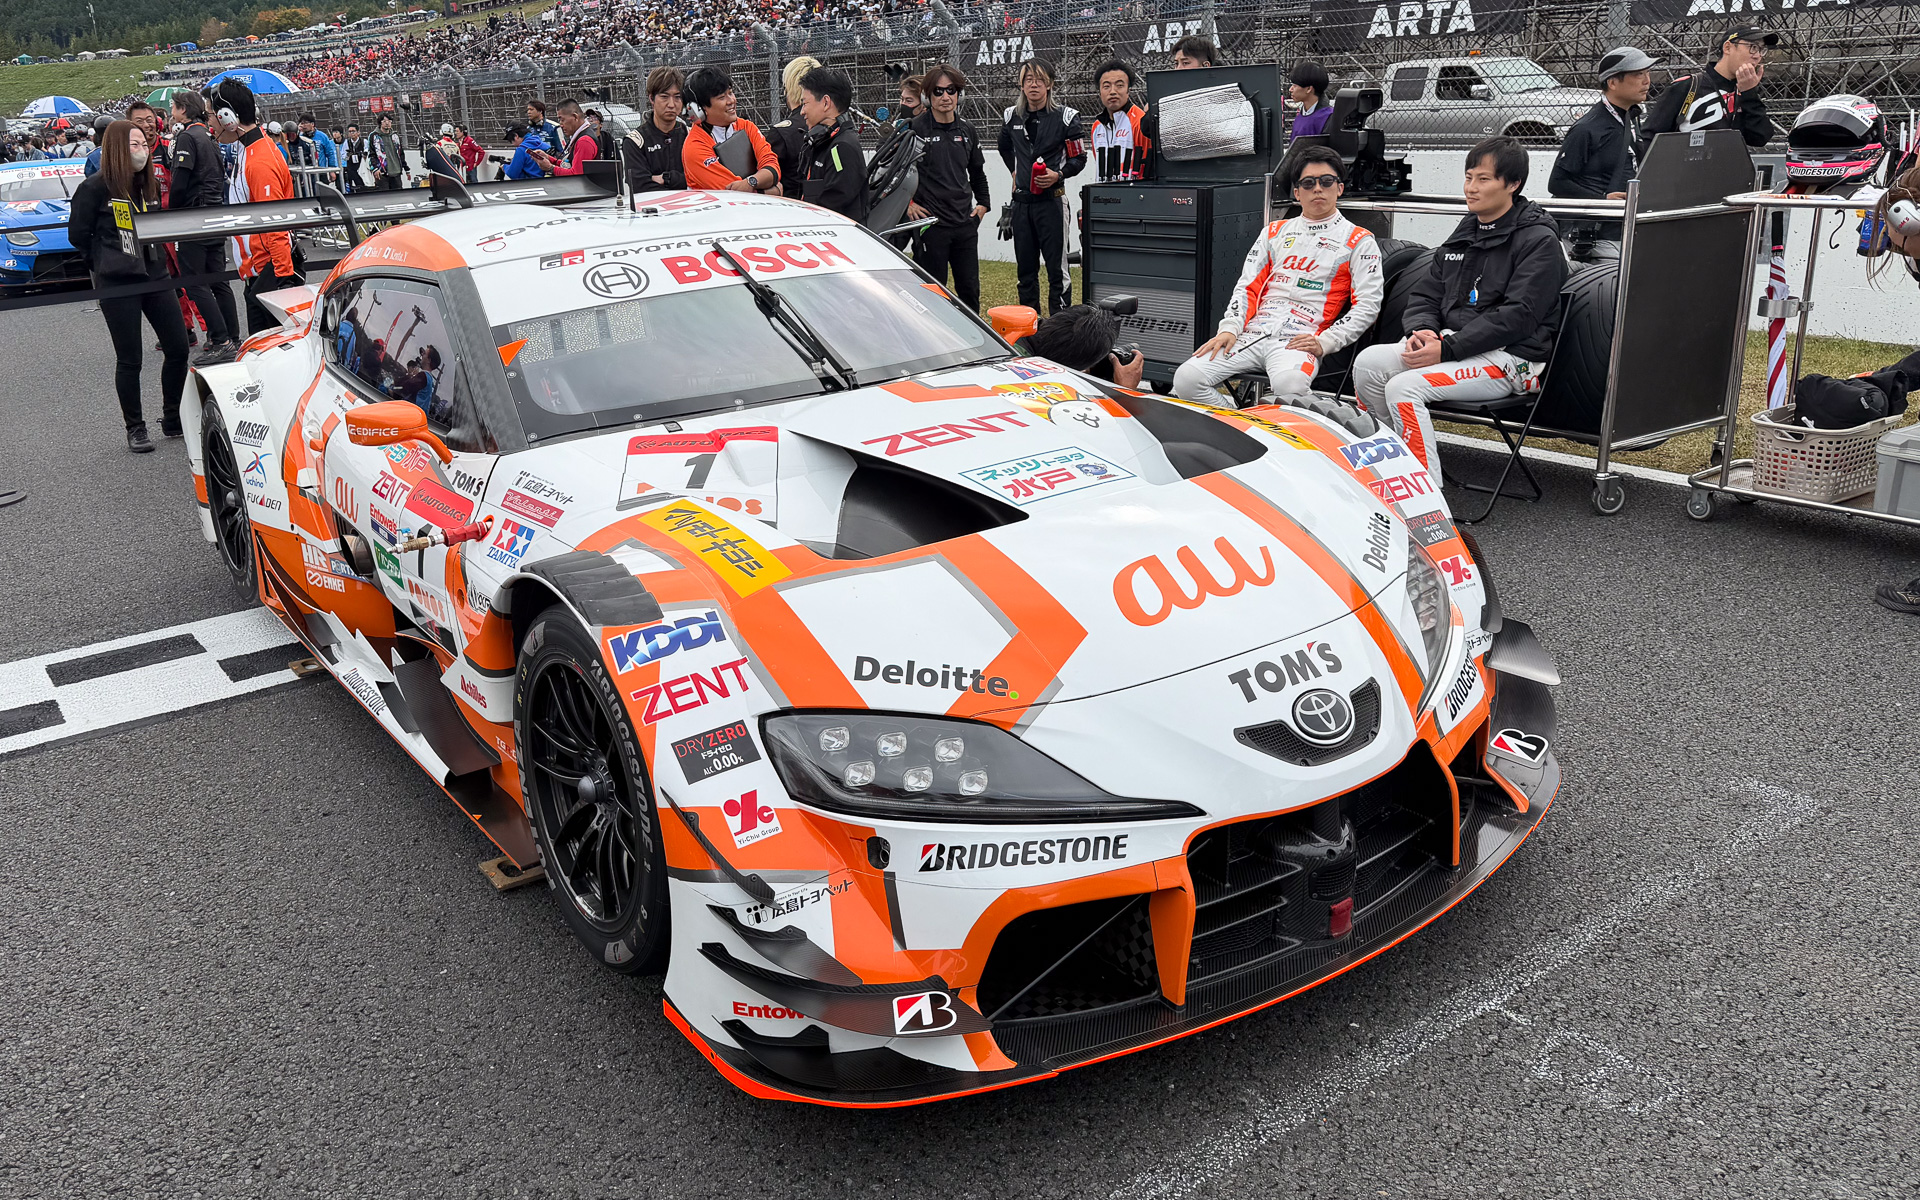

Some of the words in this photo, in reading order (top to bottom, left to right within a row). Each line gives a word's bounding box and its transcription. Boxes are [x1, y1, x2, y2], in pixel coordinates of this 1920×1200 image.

[1366, 0, 1476, 39] ARTA
[976, 35, 1035, 66] ARTA
[41, 167, 85, 178] BOSC
[1790, 166, 1846, 176] BRIDGESTONE
[264, 184, 271, 197] 1
[1308, 224, 1328, 232] TOM'S
[1898, 216, 1910, 229] OM'S
[541, 254, 585, 269] GR
[593, 240, 692, 260] TOYOTA
[697, 232, 773, 247] GAZOO
[776, 228, 837, 240] Racing
[660, 241, 857, 285] BOSCH
[1282, 255, 1319, 273] au
[1120, 315, 1190, 335] nap-on
[235, 420, 270, 441] MASEKI
[357, 427, 399, 437] EDIFICE
[860, 411, 1030, 457] ZENT
[976, 452, 1085, 482] ネッツトヨタ
[1340, 436, 1408, 469] KDDI
[452, 470, 485, 497] TOM'S
[684, 453, 718, 489] 1
[1002, 467, 1077, 499] 水戸
[1368, 470, 1434, 504] ZENT
[335, 476, 359, 523] au
[371, 469, 412, 508] ZENT
[523, 478, 574, 505] 広島トヨペット
[370, 502, 398, 536] Entowa's
[421, 495, 466, 522] AUTOBACS
[486, 546, 520, 569] TAMIYA
[1362, 512, 1391, 574] Deloitte.
[323, 575, 346, 593] ENKEI
[1112, 536, 1276, 627] au
[407, 577, 446, 623] PONOS
[609, 611, 727, 672] KDDI
[853, 655, 1020, 700] Deloitte.
[1228, 641, 1343, 703] TOM'S
[1444, 648, 1478, 722] BRIDGES
[342, 667, 387, 717] BRIDGESTONE
[632, 657, 750, 723] ZENT
[590, 659, 654, 854] BRIDGESTONE
[701, 743, 733, 760] ドライゼロ
[761, 825, 780, 837] Group
[918, 833, 1129, 873] BRIDGESTONE
[732, 1001, 806, 1020] Entow
